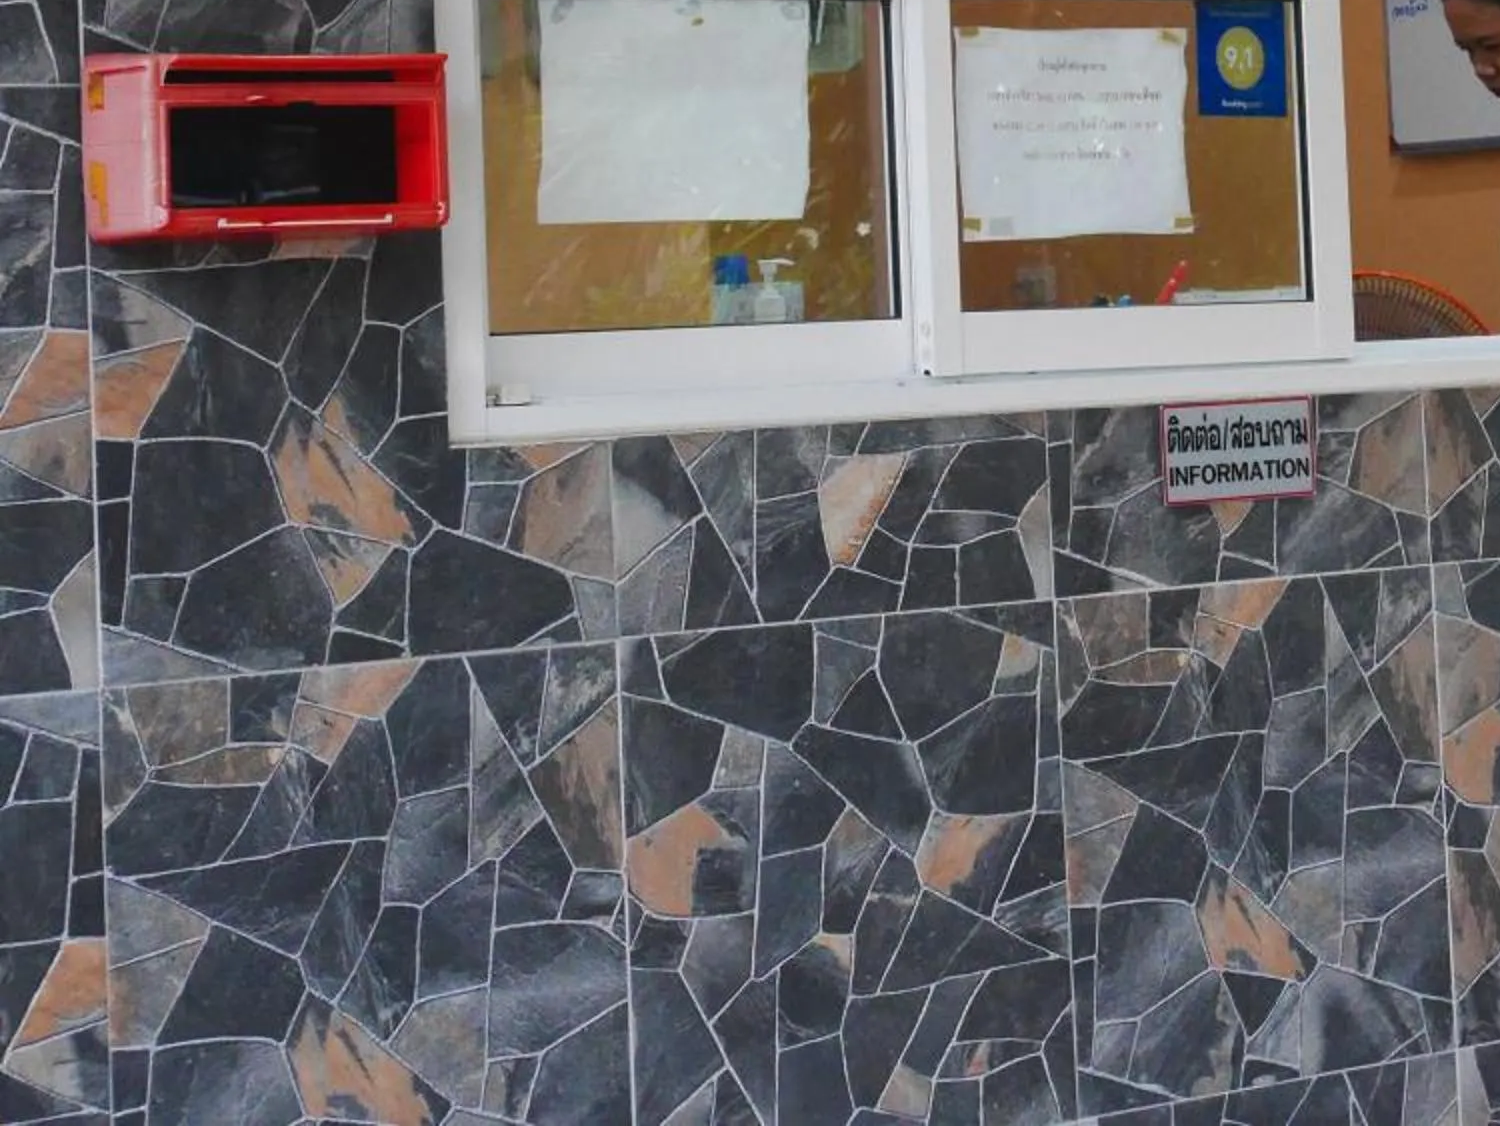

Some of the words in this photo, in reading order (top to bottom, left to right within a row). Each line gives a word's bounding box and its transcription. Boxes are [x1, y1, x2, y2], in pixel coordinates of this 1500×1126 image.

[1167, 412, 1309, 454] ติดต่อ/สอบถาม
[1169, 457, 1310, 487] INFORMATION
